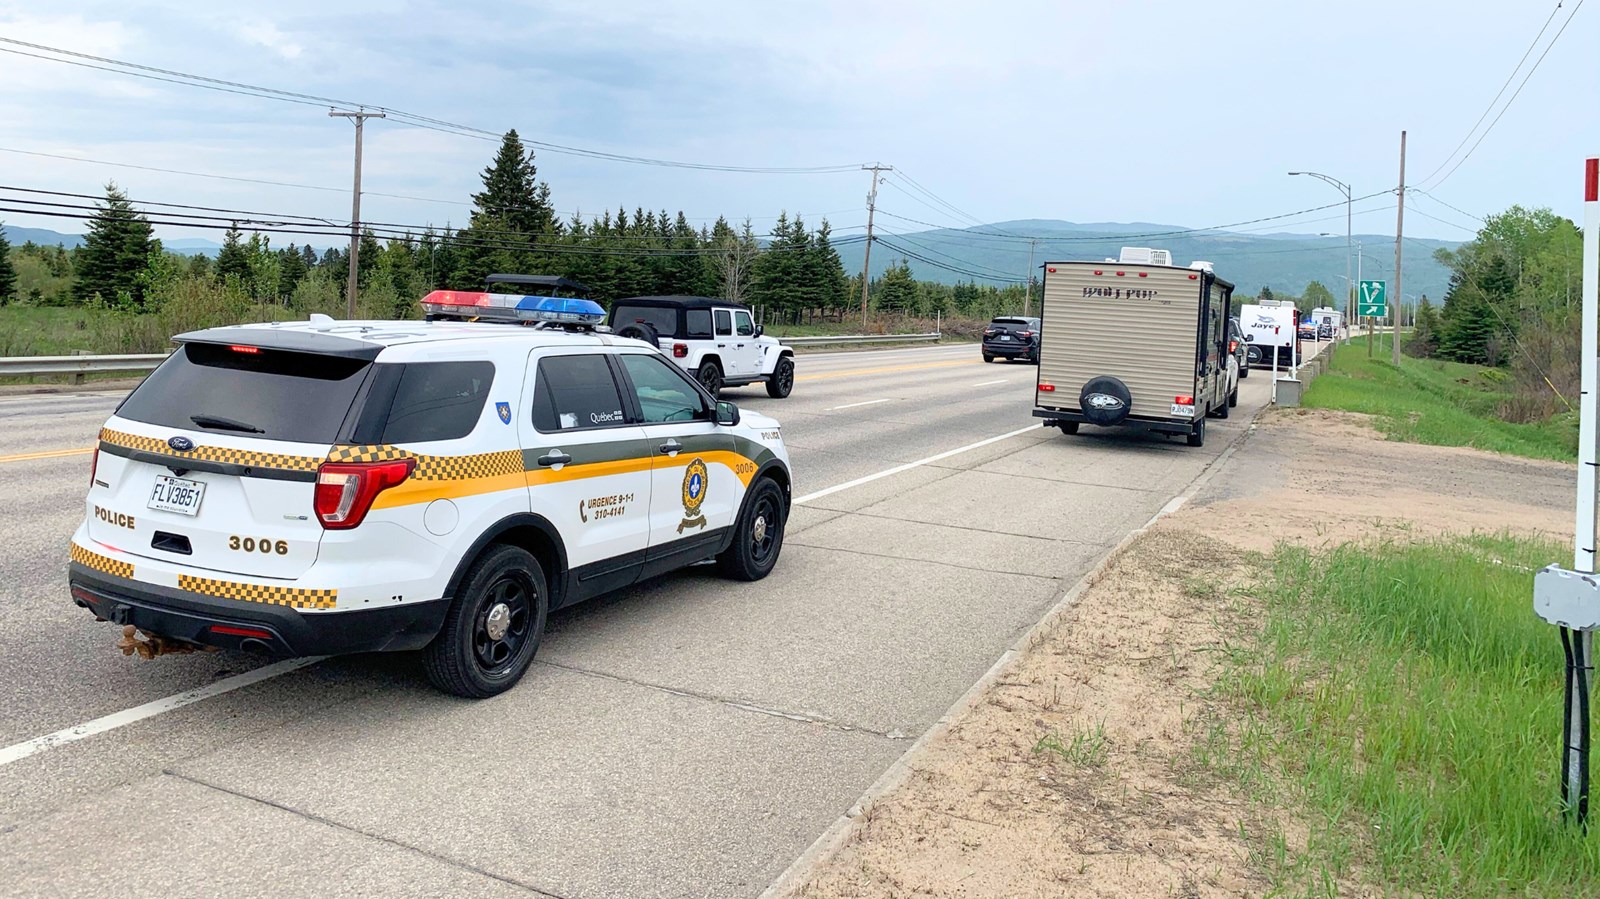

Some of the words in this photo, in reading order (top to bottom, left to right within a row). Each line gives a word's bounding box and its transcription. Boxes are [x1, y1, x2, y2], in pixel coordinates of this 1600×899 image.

[590, 411, 615, 424] Québec
[760, 431, 780, 440] POLICE
[735, 463, 754, 474] 3006
[151, 483, 201, 508] FLV3851
[587, 495, 618, 510] URGENCE
[618, 492, 635, 504] 9-1-1
[94, 504, 136, 530] POLICE
[594, 506, 626, 521] 310-4141
[228, 535, 289, 556] 3006
